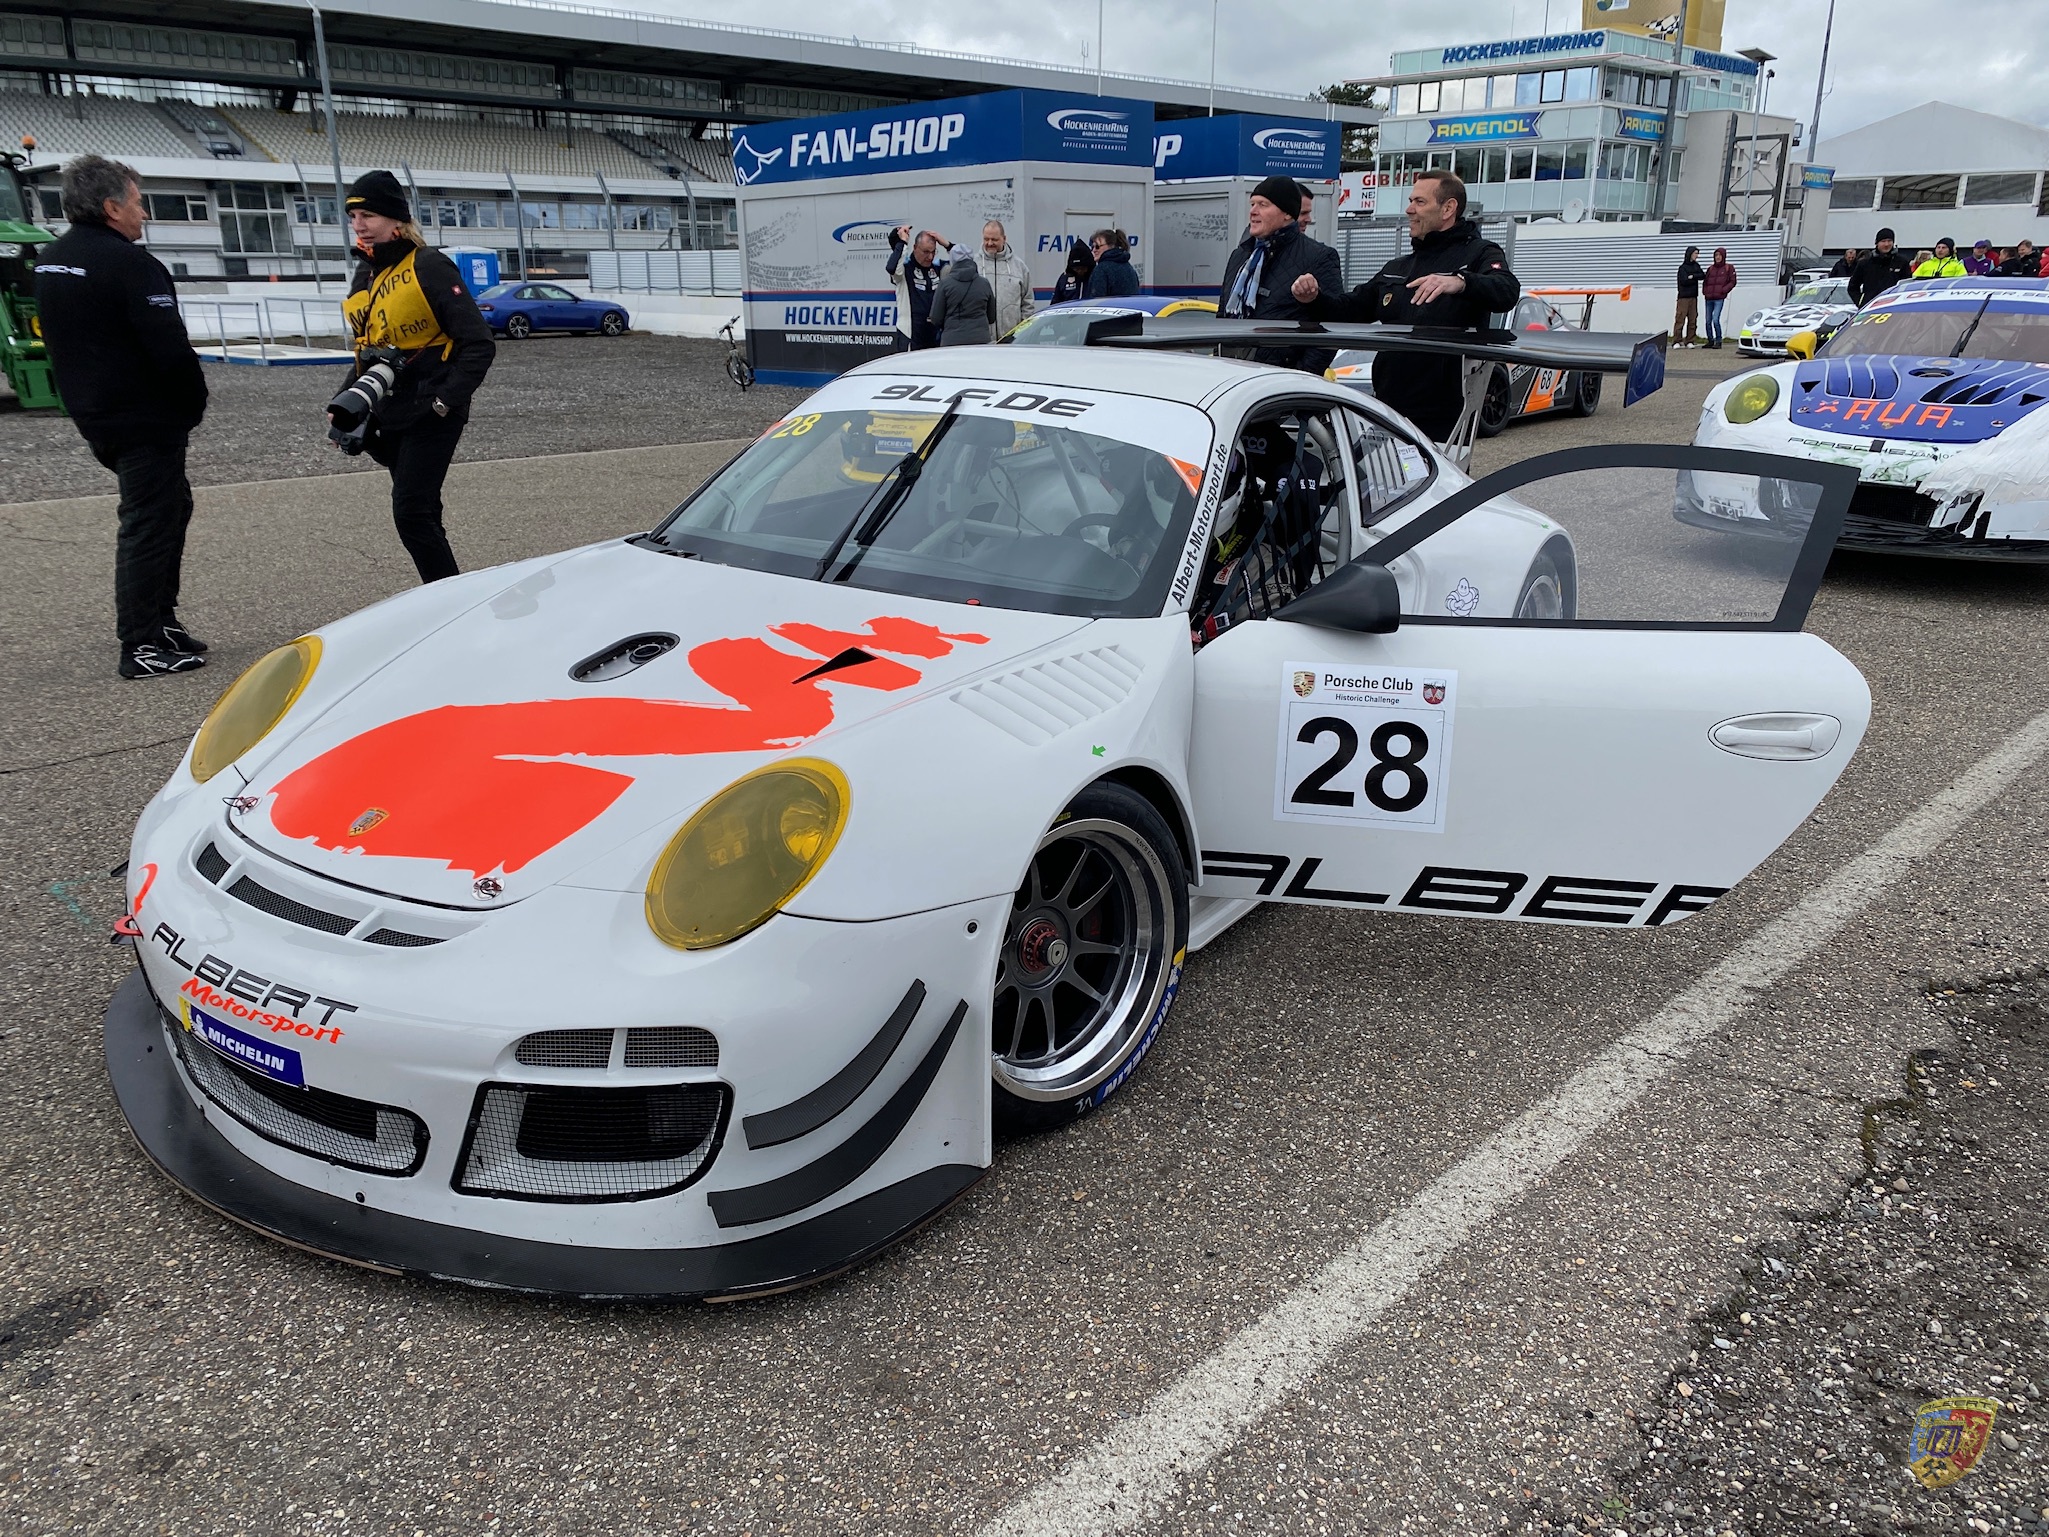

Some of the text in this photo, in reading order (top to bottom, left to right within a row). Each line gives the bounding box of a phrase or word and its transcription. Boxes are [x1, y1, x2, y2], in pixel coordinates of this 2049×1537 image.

[1442, 31, 1605, 64] HOCKENHEIMRING
[1436, 117, 1530, 138] RAVENOL
[1624, 115, 1665, 135] RAVENO
[789, 113, 966, 168] FAN-SHOP
[1062, 141, 1127, 152] OFFICIAL MERCHANDISE
[1265, 160, 1323, 170] OFFICIAL MERCHANDISE
[1804, 171, 1832, 184] RAVENOL
[1906, 290, 1944, 299] GT
[377, 308, 388, 330] 3
[400, 318, 429, 338] Foto
[1864, 312, 1893, 325] 78
[785, 333, 893, 346] WWW.HOCKENHEIMRING.DE/FANSHOP
[1540, 370, 1553, 390] 68
[871, 384, 1096, 418] 9LF.DE
[770, 412, 822, 439] 28
[1843, 401, 1954, 429] AUA
[1170, 443, 1228, 607] Albert-Motorsport.de
[1324, 673, 1413, 691] Porsche Club
[1335, 693, 1400, 705] Historic Challenge
[1290, 716, 1429, 813] 28
[151, 921, 359, 1027] ALBERT
[180, 976, 346, 1045] Motorsport
[207, 1026, 286, 1073] MICHELIN
[1102, 991, 1174, 1099] MICHELIN
